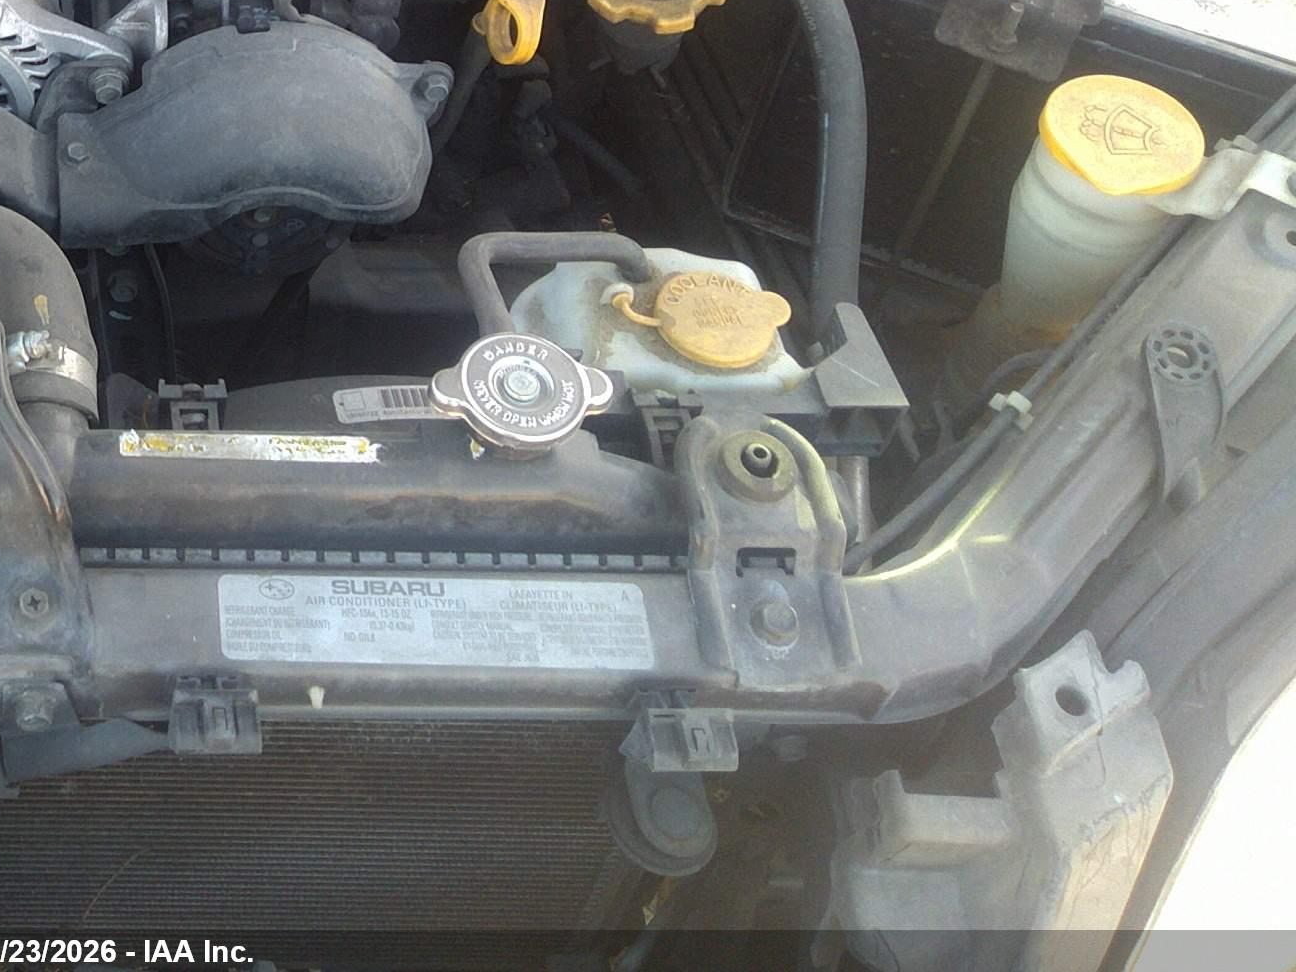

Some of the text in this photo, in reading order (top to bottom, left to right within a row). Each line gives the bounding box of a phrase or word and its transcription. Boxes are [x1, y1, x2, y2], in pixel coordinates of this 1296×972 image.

[664, 274, 753, 305] COOLANT
[473, 379, 576, 429] NEVER OPEN WHEN HOT
[331, 579, 445, 597] SUBARU
[508, 589, 559, 600] LAFAYETTE
[620, 590, 630, 601] A
[305, 595, 326, 605] AIR
[329, 595, 411, 608] CONDITIONER
